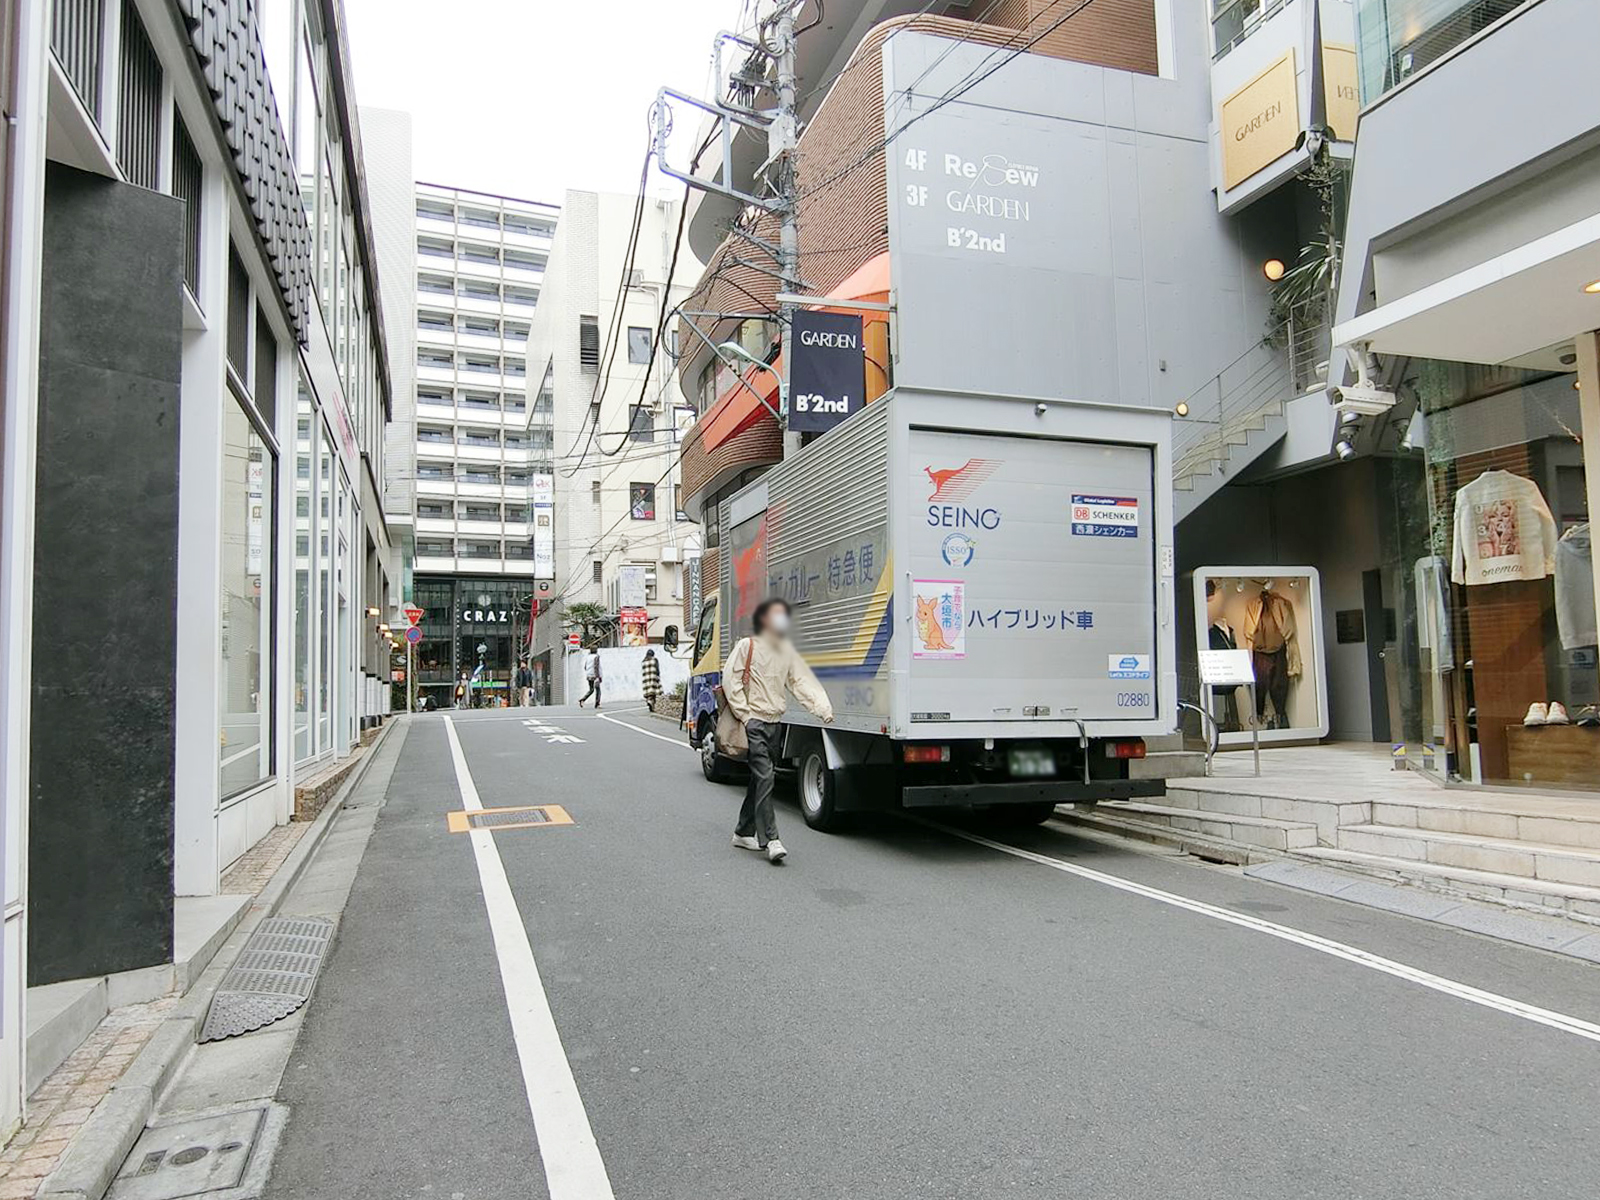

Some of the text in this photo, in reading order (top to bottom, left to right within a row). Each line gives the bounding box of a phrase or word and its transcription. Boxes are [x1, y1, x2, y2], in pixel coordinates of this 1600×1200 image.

[1234, 101, 1281, 142] GARDEN
[905, 148, 927, 171] 4F
[906, 184, 1029, 221] 3F GARDEN
[946, 226, 1006, 253] B'2nd
[800, 330, 857, 349] GARDEN
[796, 393, 849, 414] B'2nd
[927, 505, 1001, 530] SEINO
[1075, 508, 1136, 521] DB SCHENKER
[828, 542, 875, 594] 特急便
[941, 592, 952, 629] 大垣市
[967, 609, 1094, 630] ハイブリッド車
[1117, 692, 1150, 707] 02880
